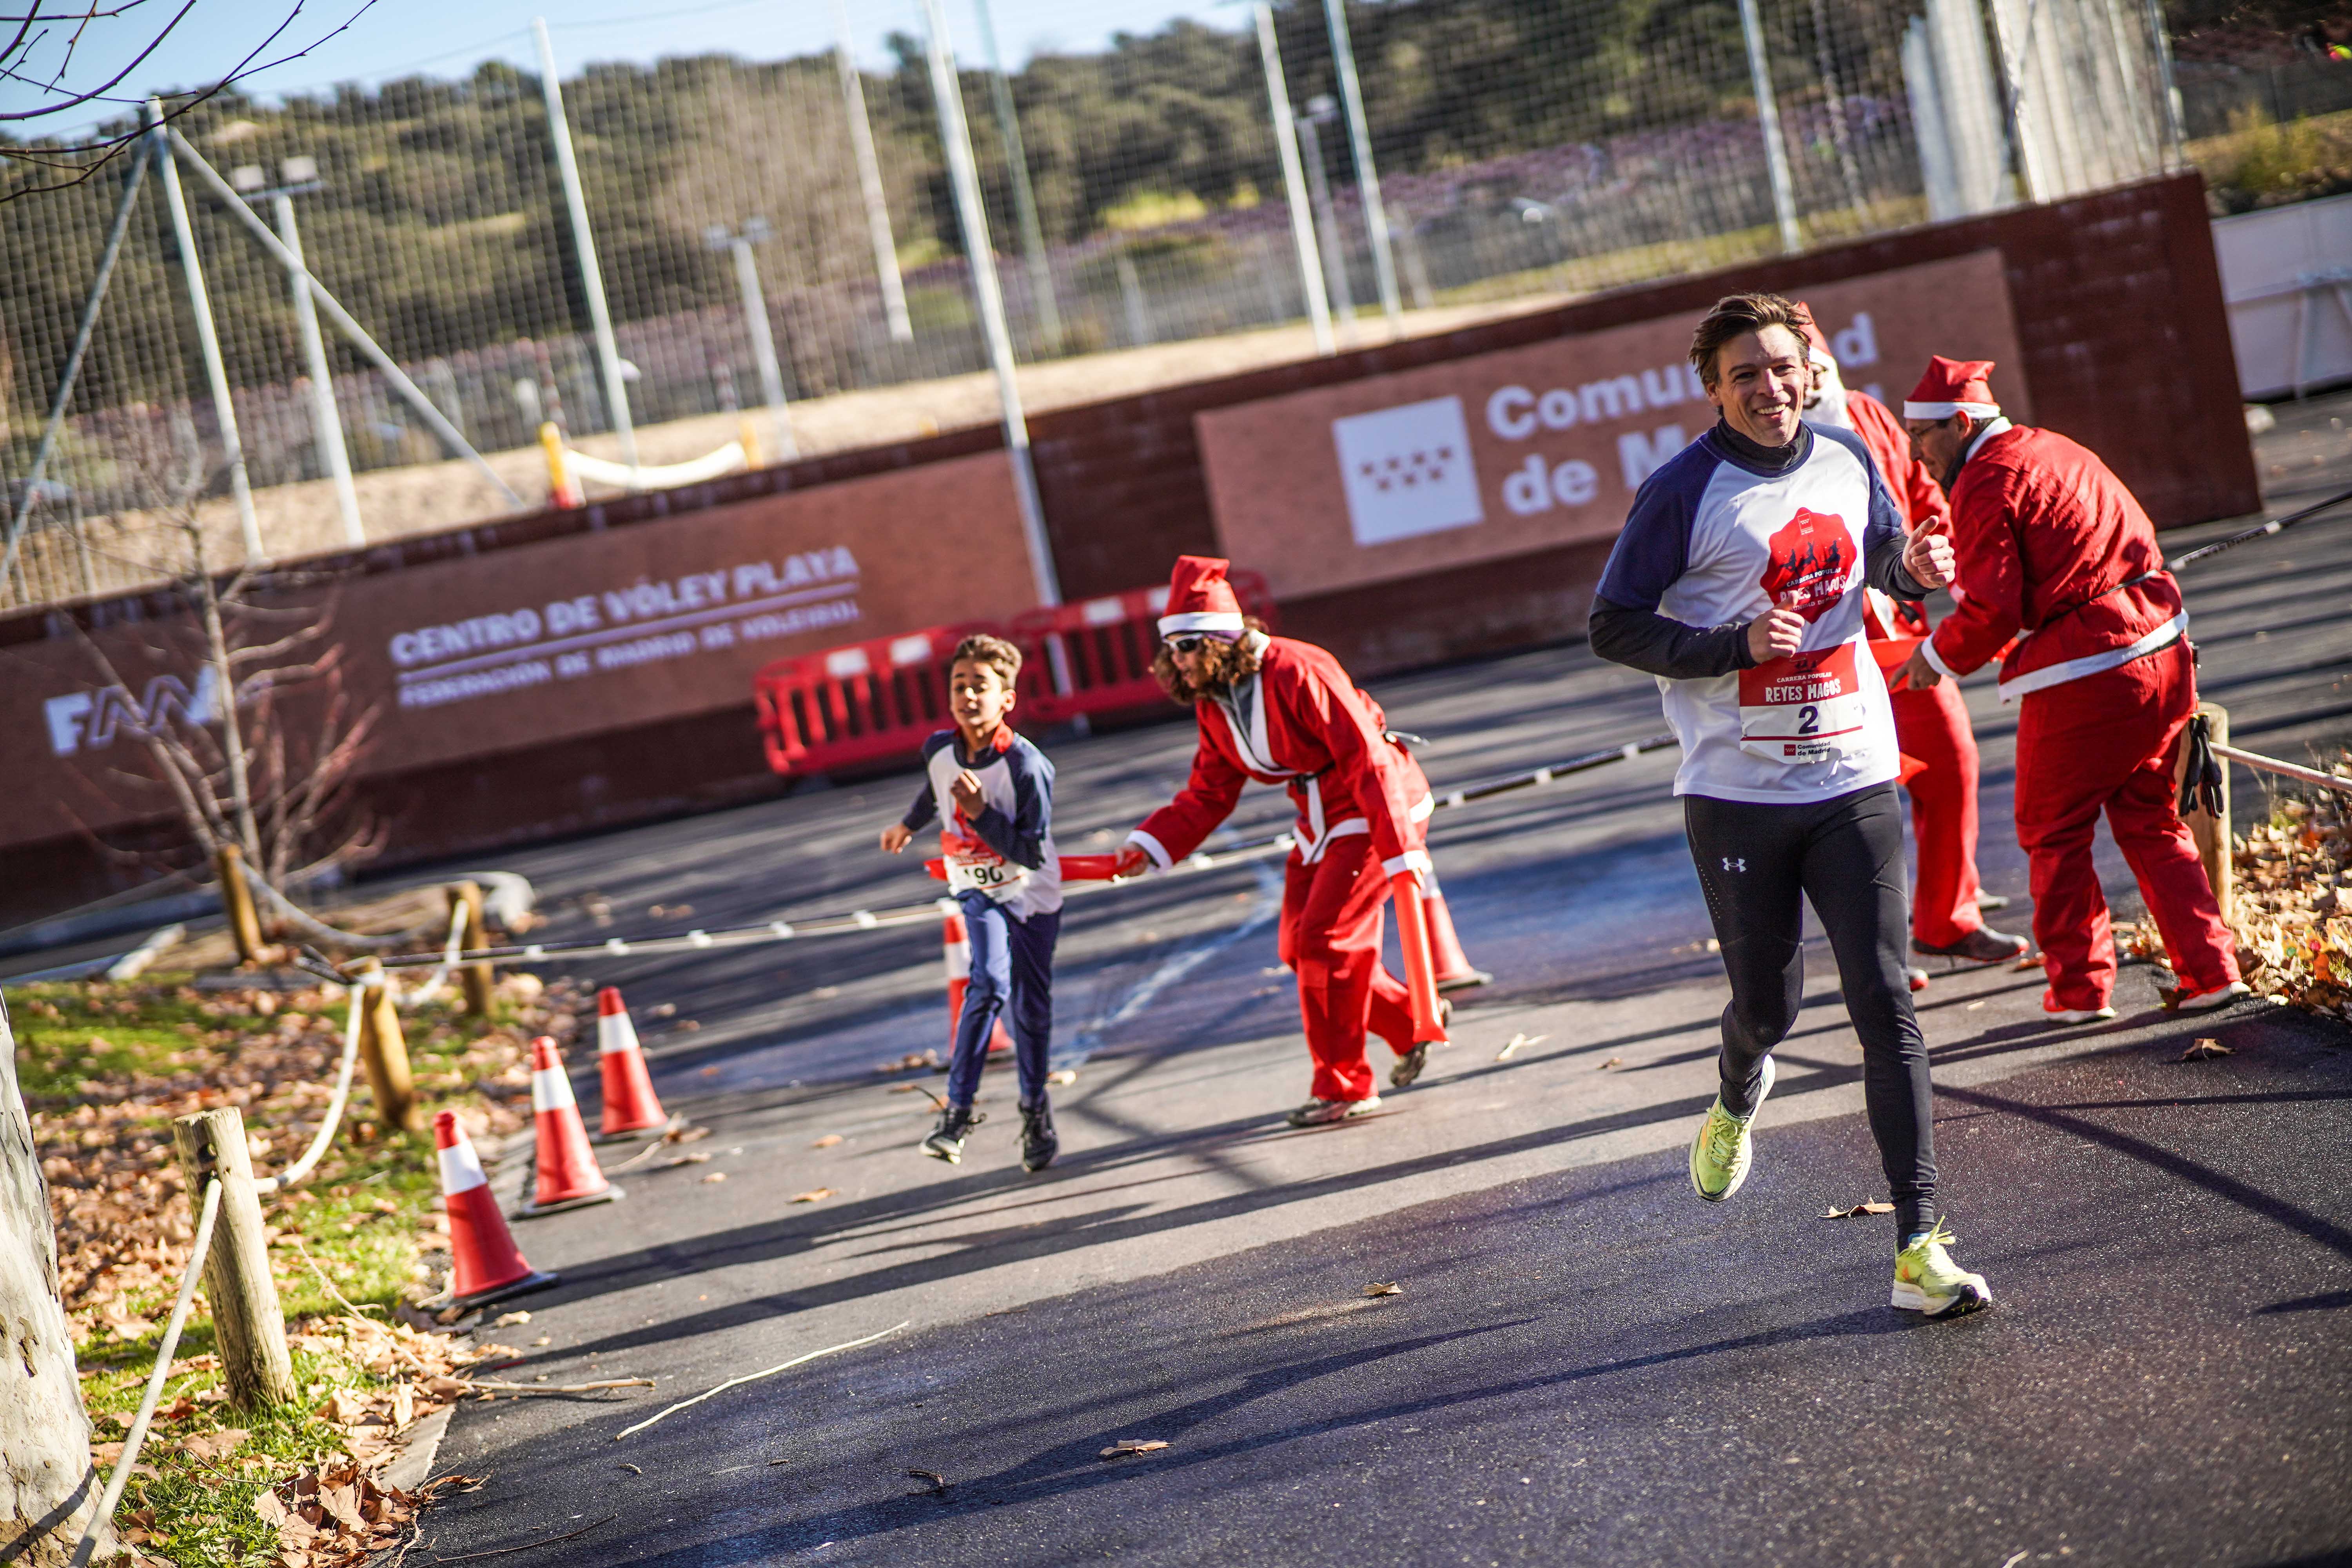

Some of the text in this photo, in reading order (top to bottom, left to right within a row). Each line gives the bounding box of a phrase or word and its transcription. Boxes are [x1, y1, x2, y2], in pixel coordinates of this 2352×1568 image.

[1487, 312, 1878, 440] Comud
[1502, 454, 1599, 516] de
[1787, 574, 1814, 587] CARRERA
[390, 545, 859, 664] CENTRO DE VÓLEY PLAYA
[1765, 678, 1841, 702] REYES MAGOS
[1798, 706, 1818, 734] 2
[1808, 747, 1830, 755] Madrid
